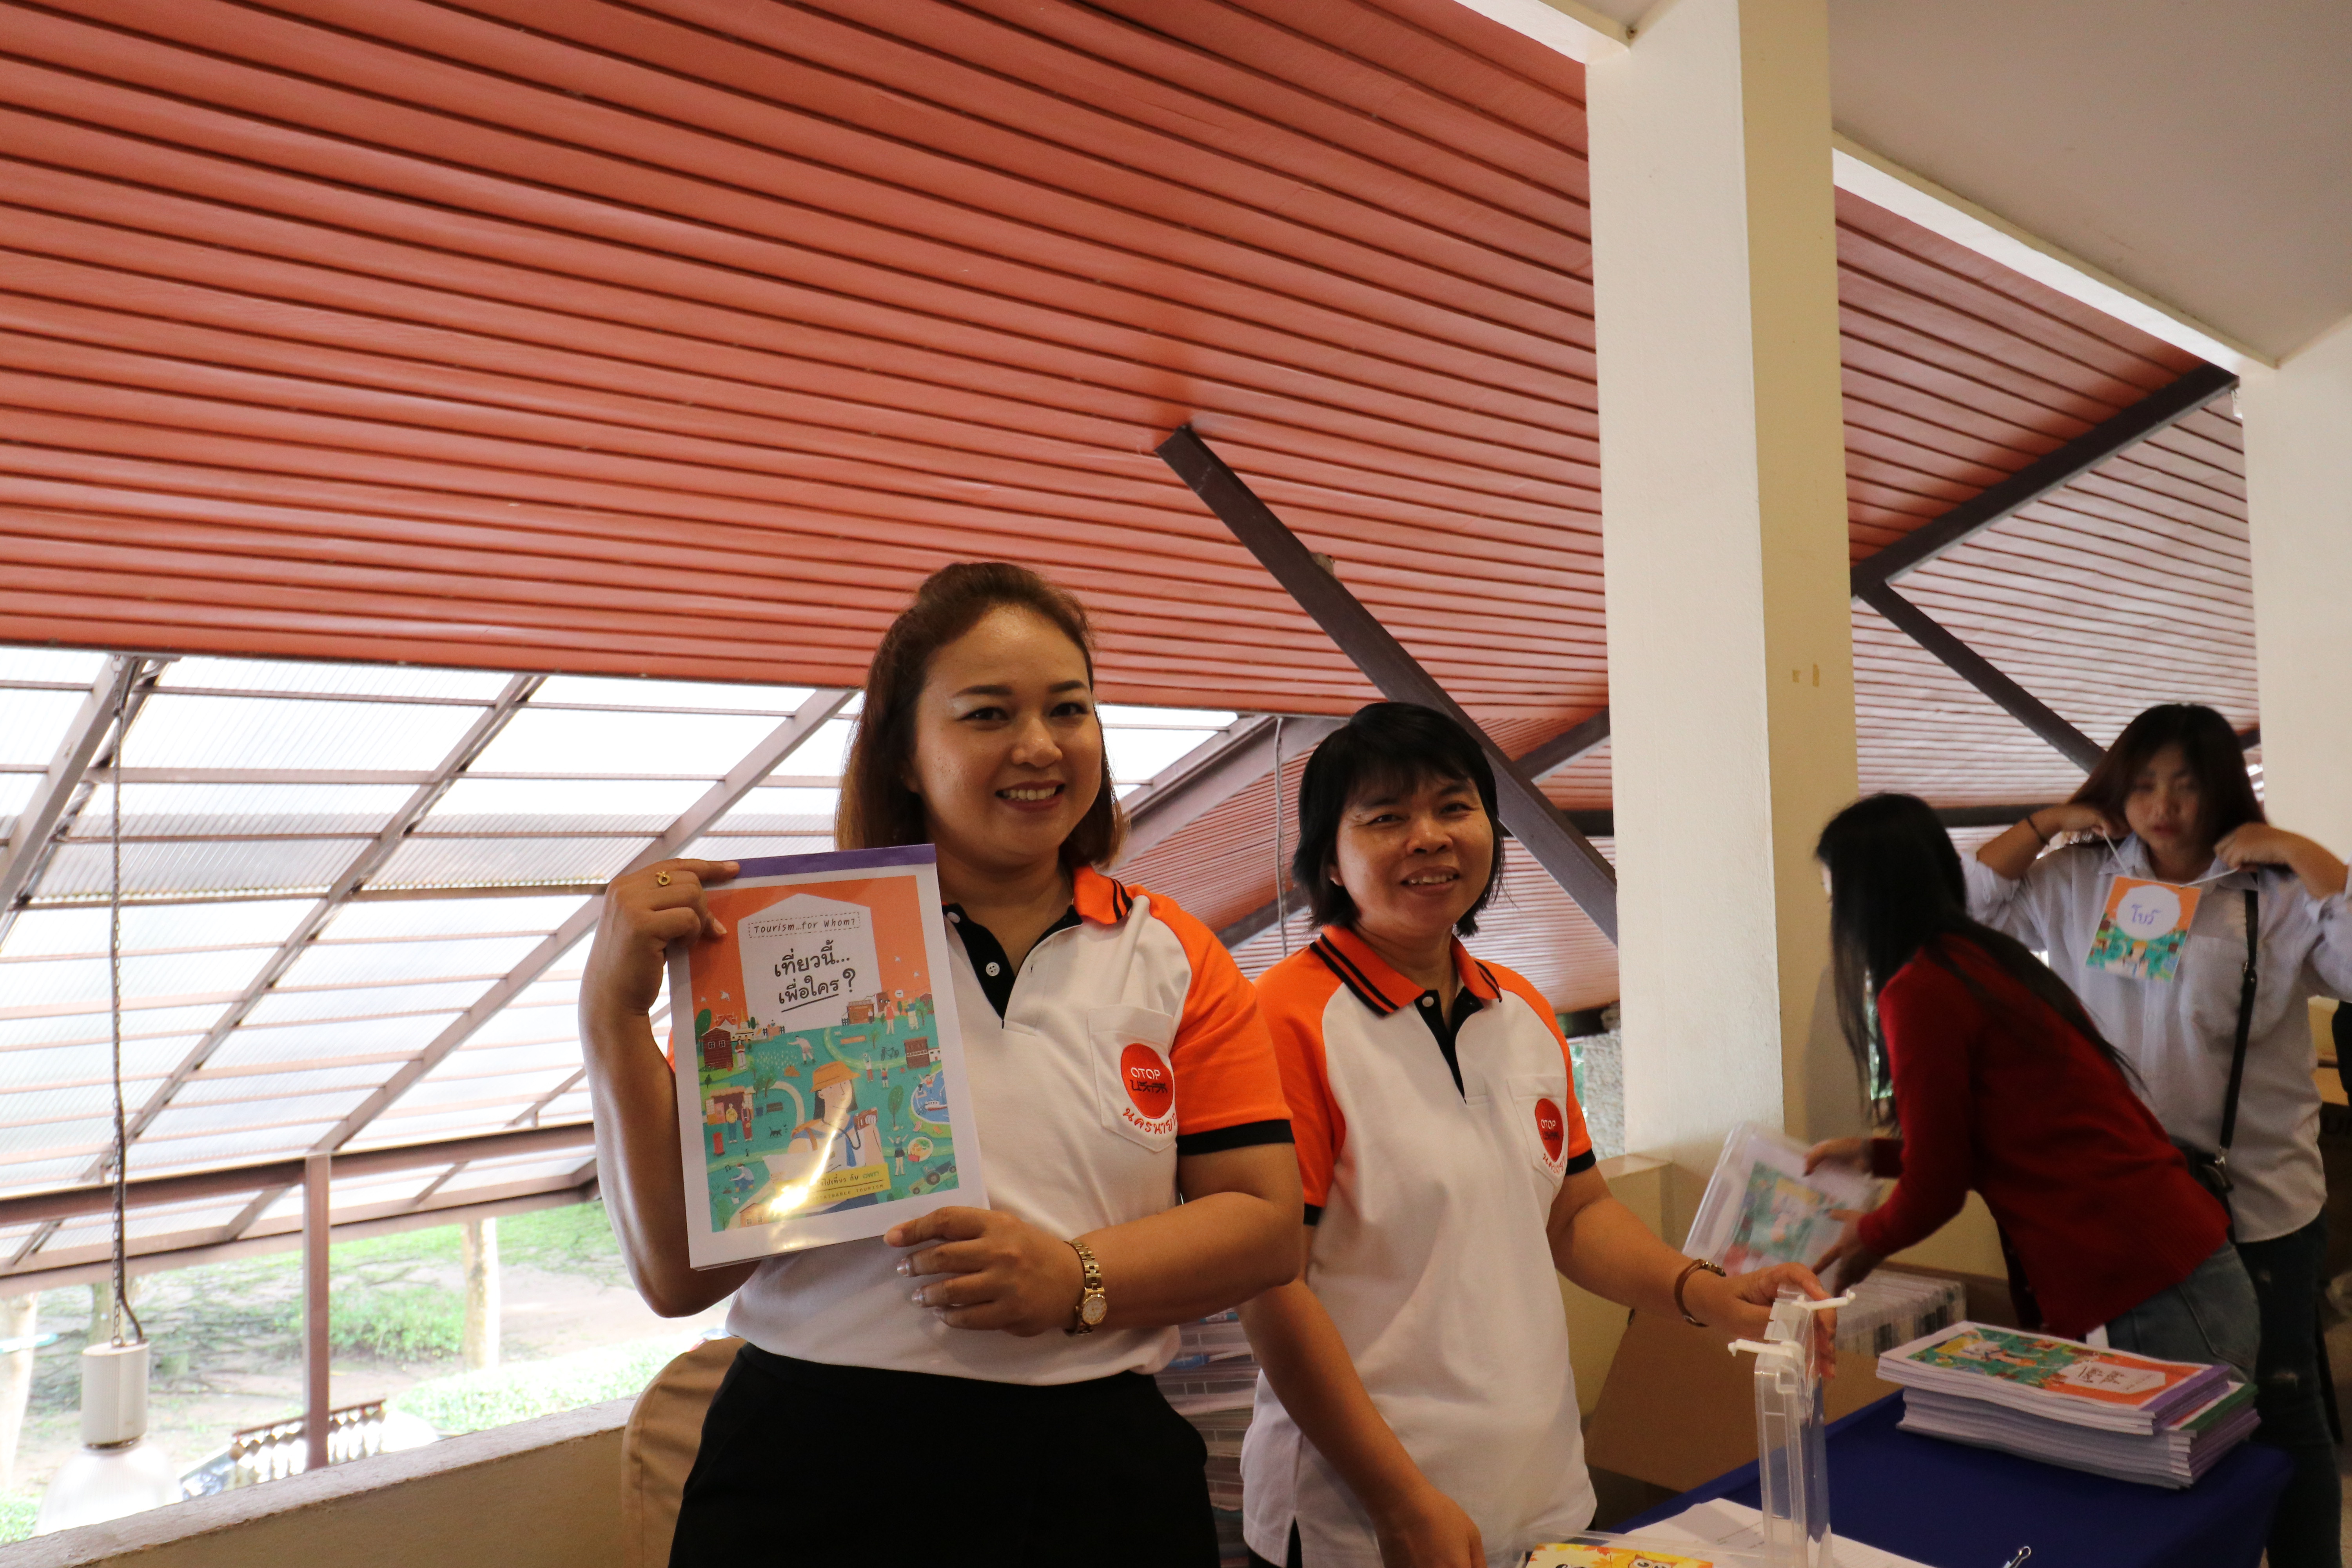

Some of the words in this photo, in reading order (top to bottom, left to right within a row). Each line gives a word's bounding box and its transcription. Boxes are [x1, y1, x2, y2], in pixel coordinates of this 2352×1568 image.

[824, 918, 855, 928] Whom?
[774, 939, 850, 977] เที่ยวนี้...
[1130, 1067, 1161, 1080] OTOP
[1540, 1119, 1556, 1130] OTOP
[856, 1184, 883, 1193] TOURISM
